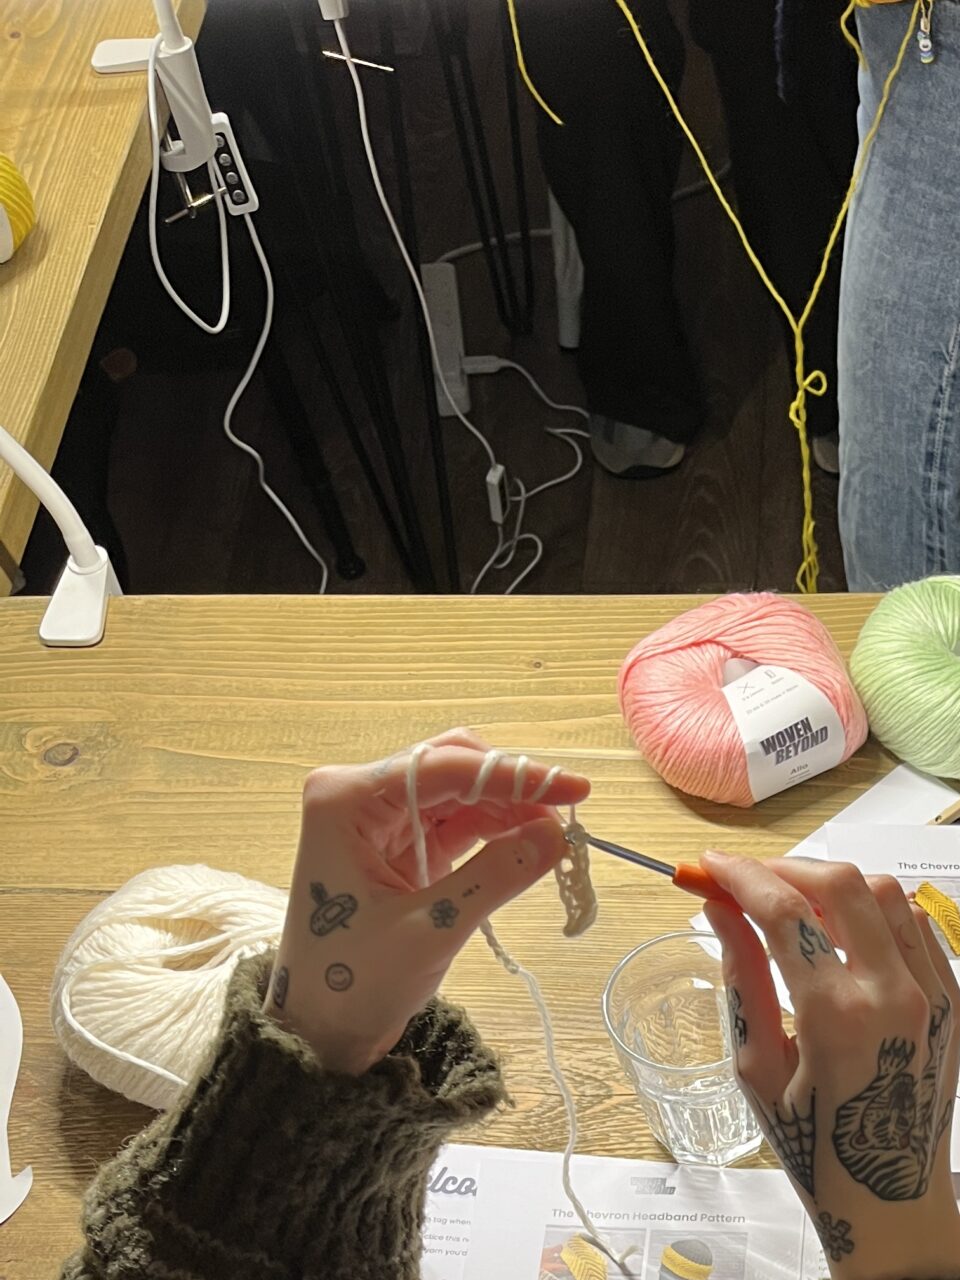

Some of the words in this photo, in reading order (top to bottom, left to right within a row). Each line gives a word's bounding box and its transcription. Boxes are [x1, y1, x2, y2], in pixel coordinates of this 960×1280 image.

[760, 717, 812, 756] WOVEN
[775, 726, 829, 765] BEYOND
[898, 862, 918, 871] The
[551, 1208, 574, 1218] The
[576, 1210, 630, 1221] hevron
[633, 1211, 698, 1223] Headband
[700, 1213, 746, 1224] Pattern
